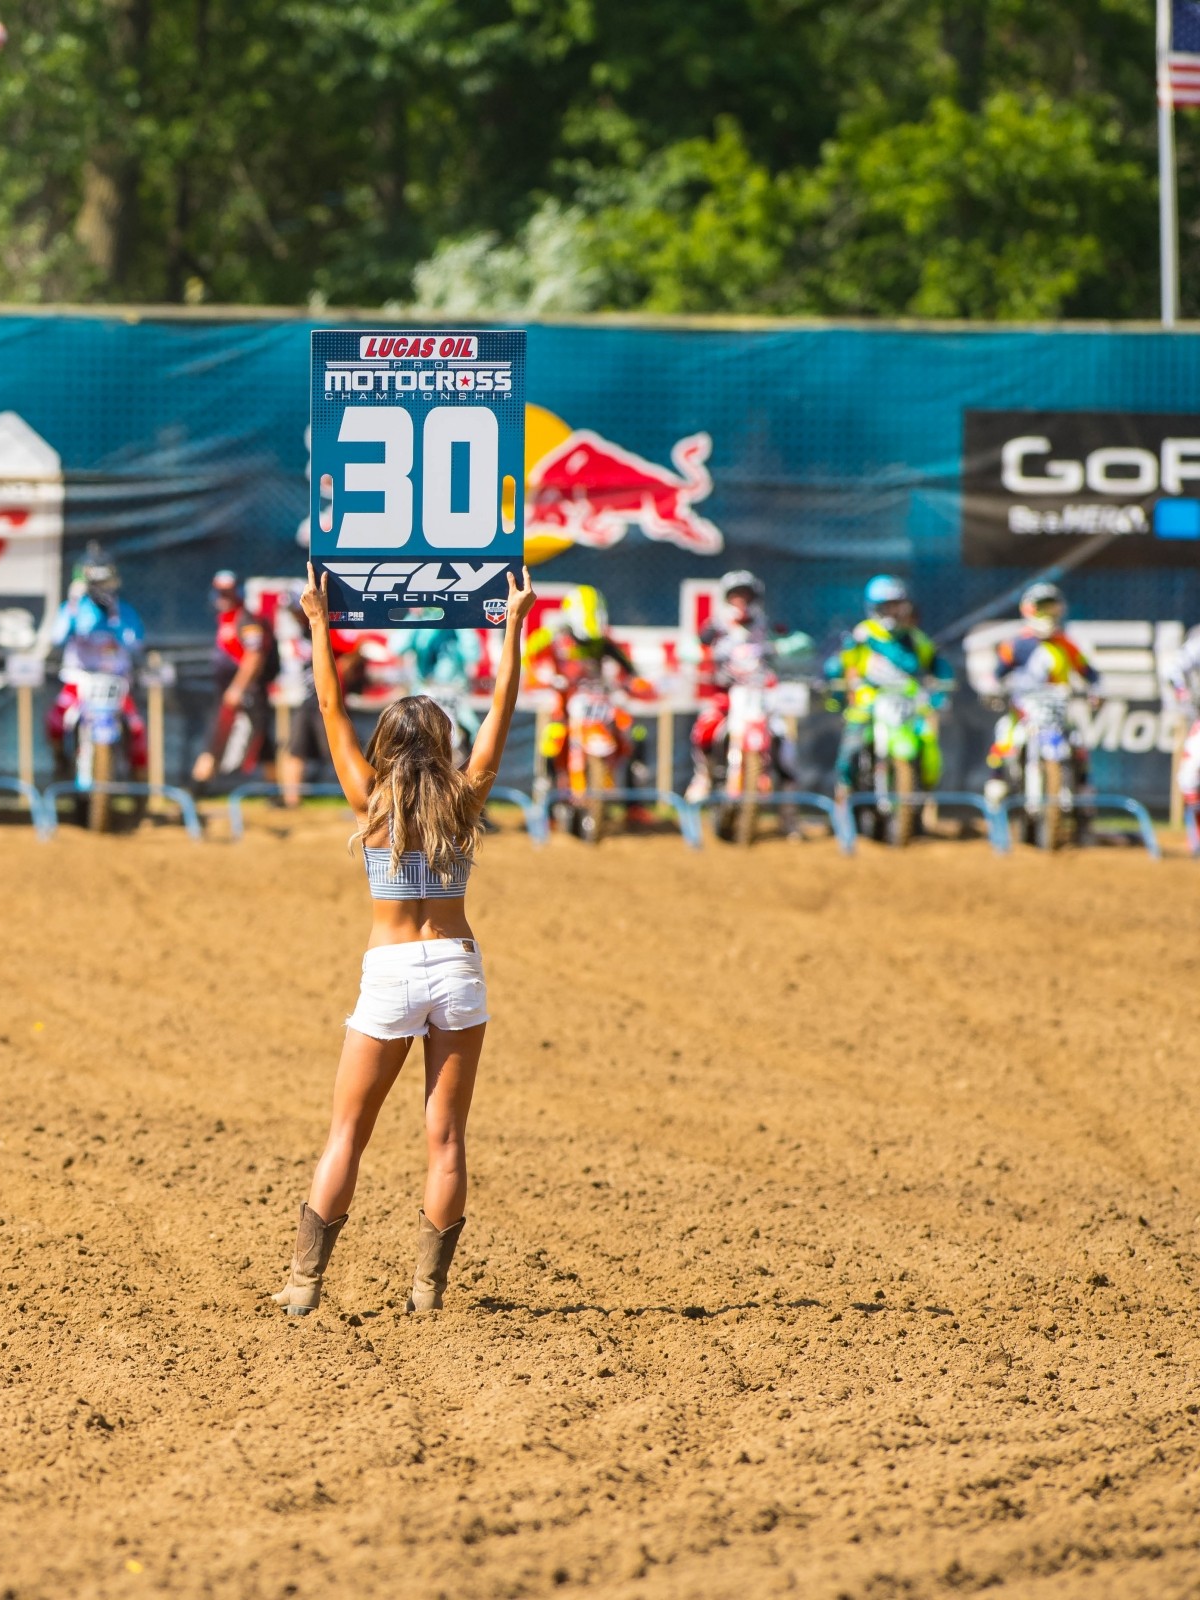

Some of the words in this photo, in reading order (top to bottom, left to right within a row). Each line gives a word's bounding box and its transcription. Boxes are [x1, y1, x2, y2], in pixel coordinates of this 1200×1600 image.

[365, 338, 436, 358] LUCAS
[438, 338, 474, 358] OIL
[393, 361, 444, 369] PRO
[325, 370, 512, 391] MOTOCROSS
[325, 392, 512, 401] CHAMPIONSHIP
[336, 406, 499, 549] 30
[322, 562, 511, 592] FLY
[362, 593, 469, 602] RACING
